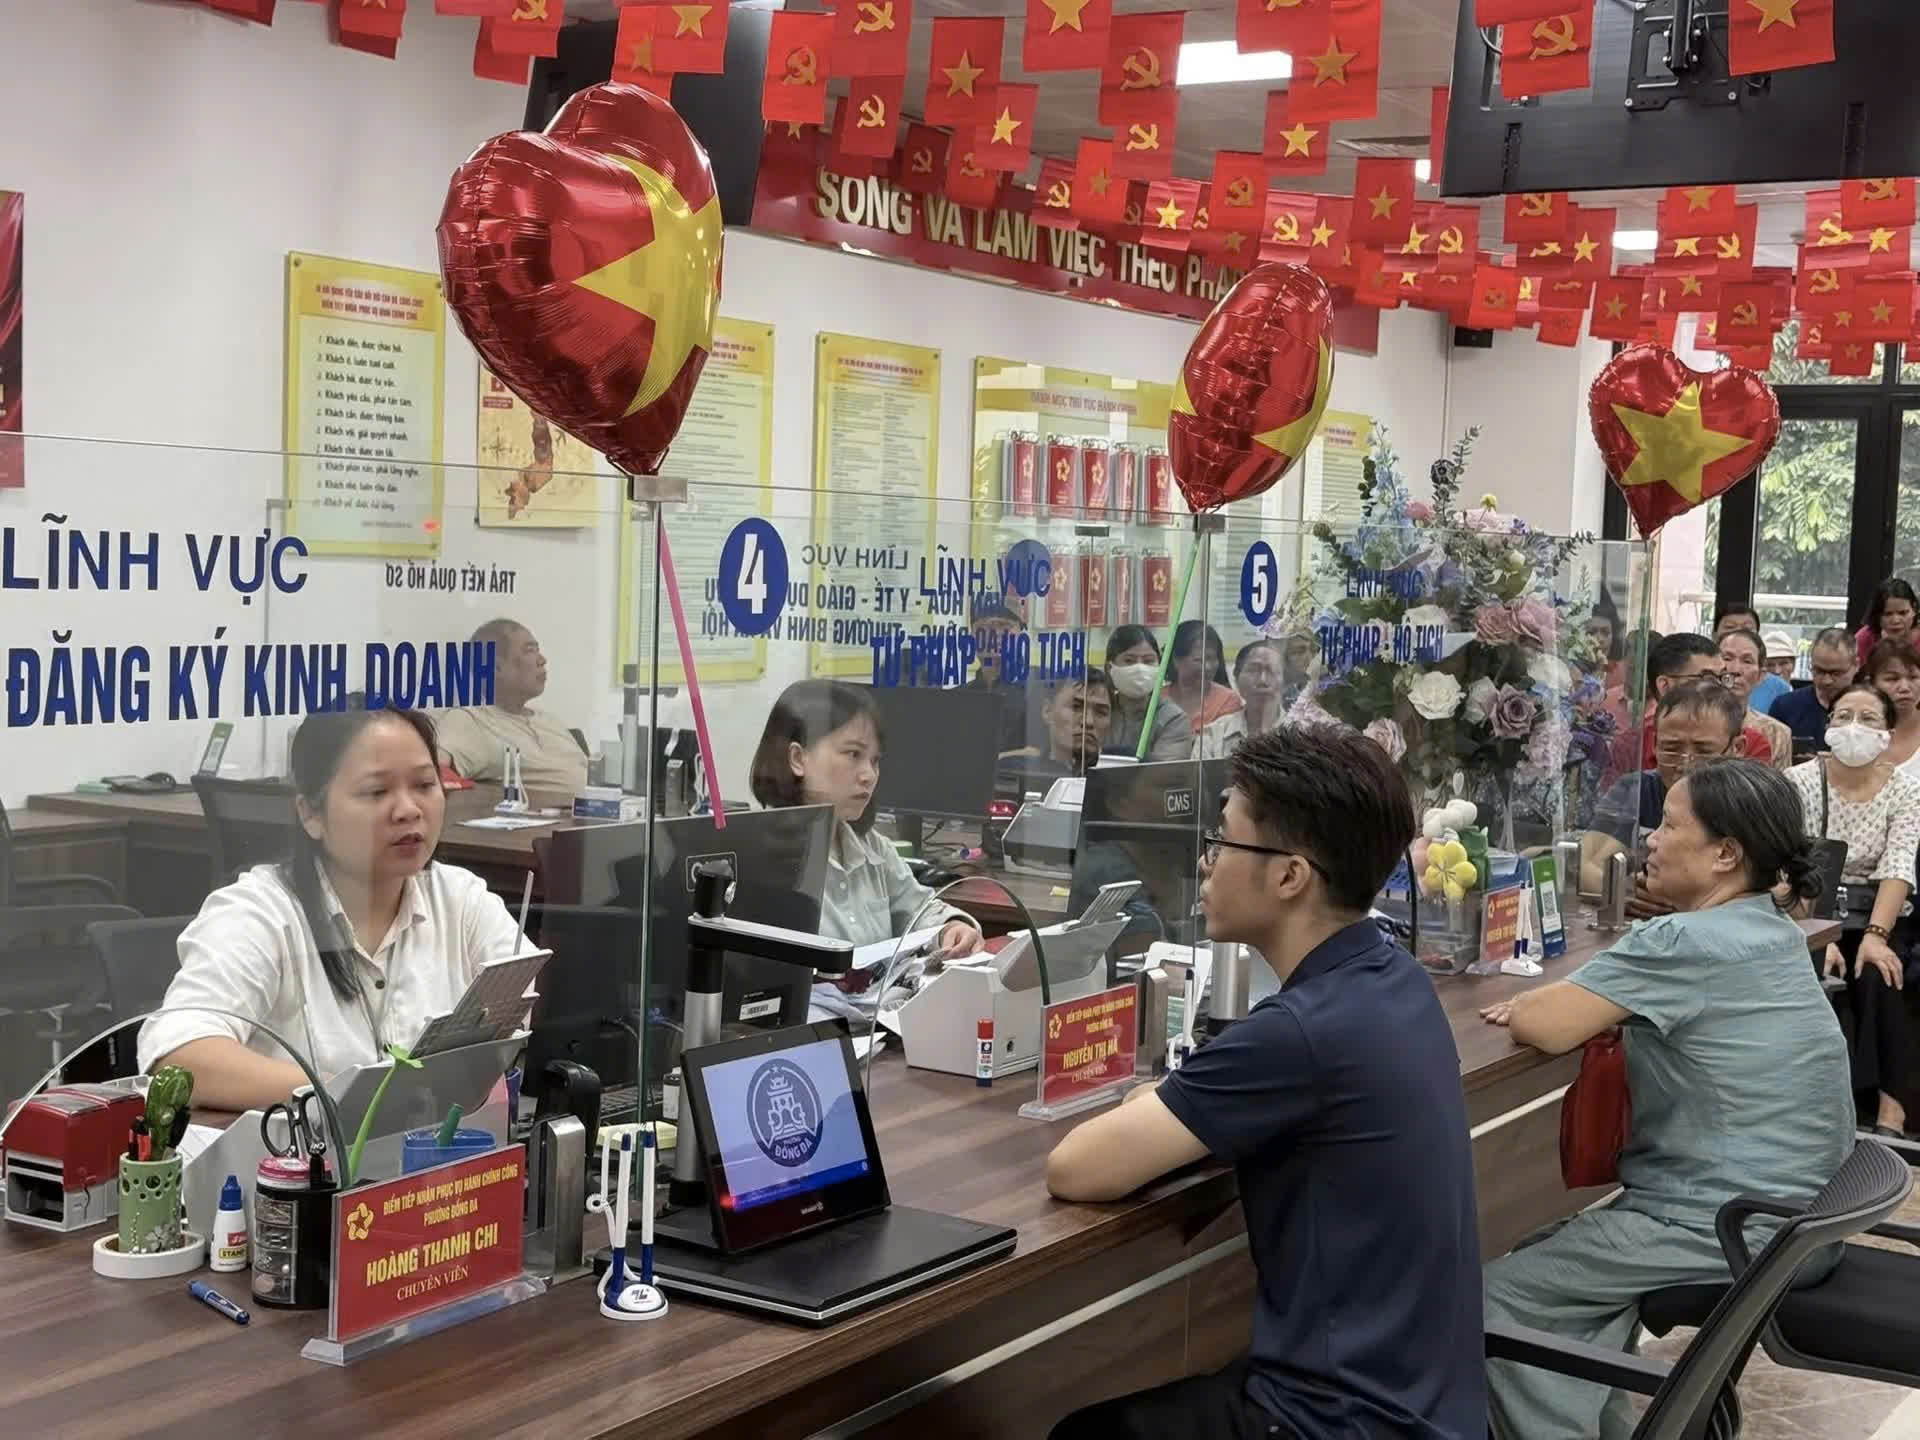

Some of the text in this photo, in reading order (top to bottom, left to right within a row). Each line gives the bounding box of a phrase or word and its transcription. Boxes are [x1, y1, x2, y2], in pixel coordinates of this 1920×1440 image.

[2, 512, 308, 605] LĨNH VỰC
[737, 533, 768, 615] 4
[920, 543, 986, 596] LĨNH
[1251, 553, 1269, 615] 5
[5, 626, 496, 728] ĐĂNG KÝ KINH DOANH
[1167, 793, 1190, 813] CMS
[416, 1185, 436, 1207] NHẬN
[436, 1182, 454, 1201] PHỤC
[464, 1173, 481, 1191] HÀNH
[481, 1167, 501, 1187] CHÍNH
[501, 1162, 518, 1181] CÔNG
[366, 1222, 499, 1286] HOÀNG THANH CHI
[397, 1264, 469, 1301] CHUYÊN VIÊN
